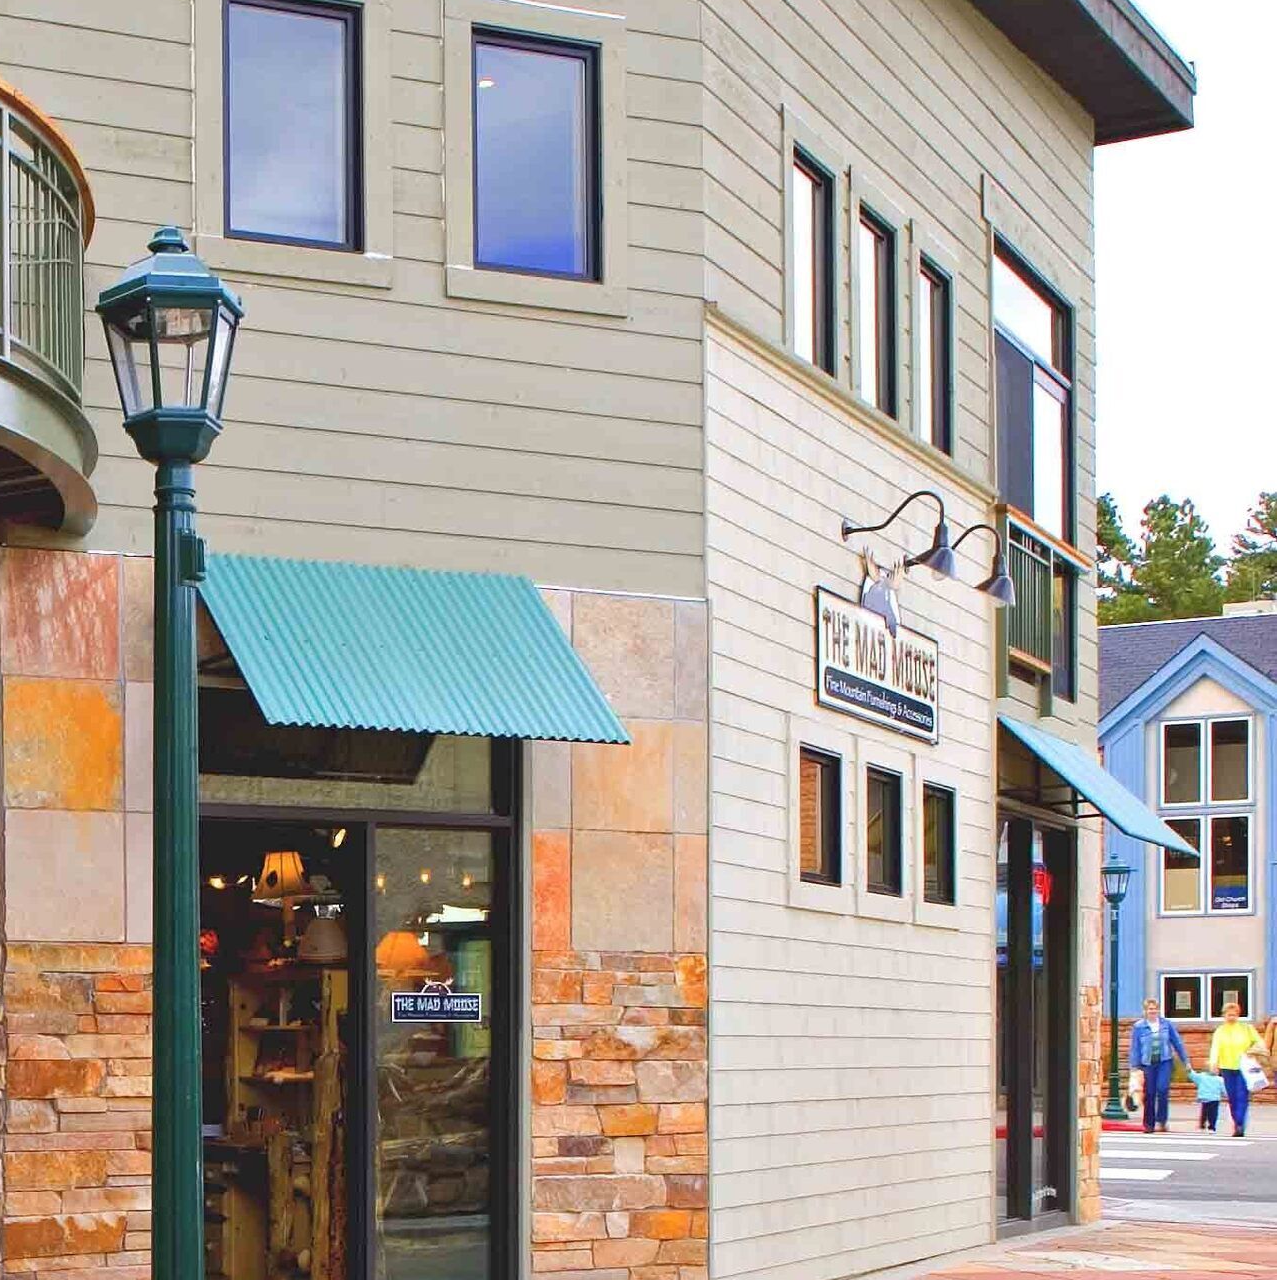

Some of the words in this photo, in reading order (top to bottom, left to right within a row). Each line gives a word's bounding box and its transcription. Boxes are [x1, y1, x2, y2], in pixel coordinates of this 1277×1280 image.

[823, 607, 850, 667] THE
[855, 622, 886, 680] MAD
[891, 639, 935, 702] MOOSE
[394, 997, 414, 1011] THE
[417, 997, 441, 1011] MAD
[443, 997, 478, 1012] MOOSE
